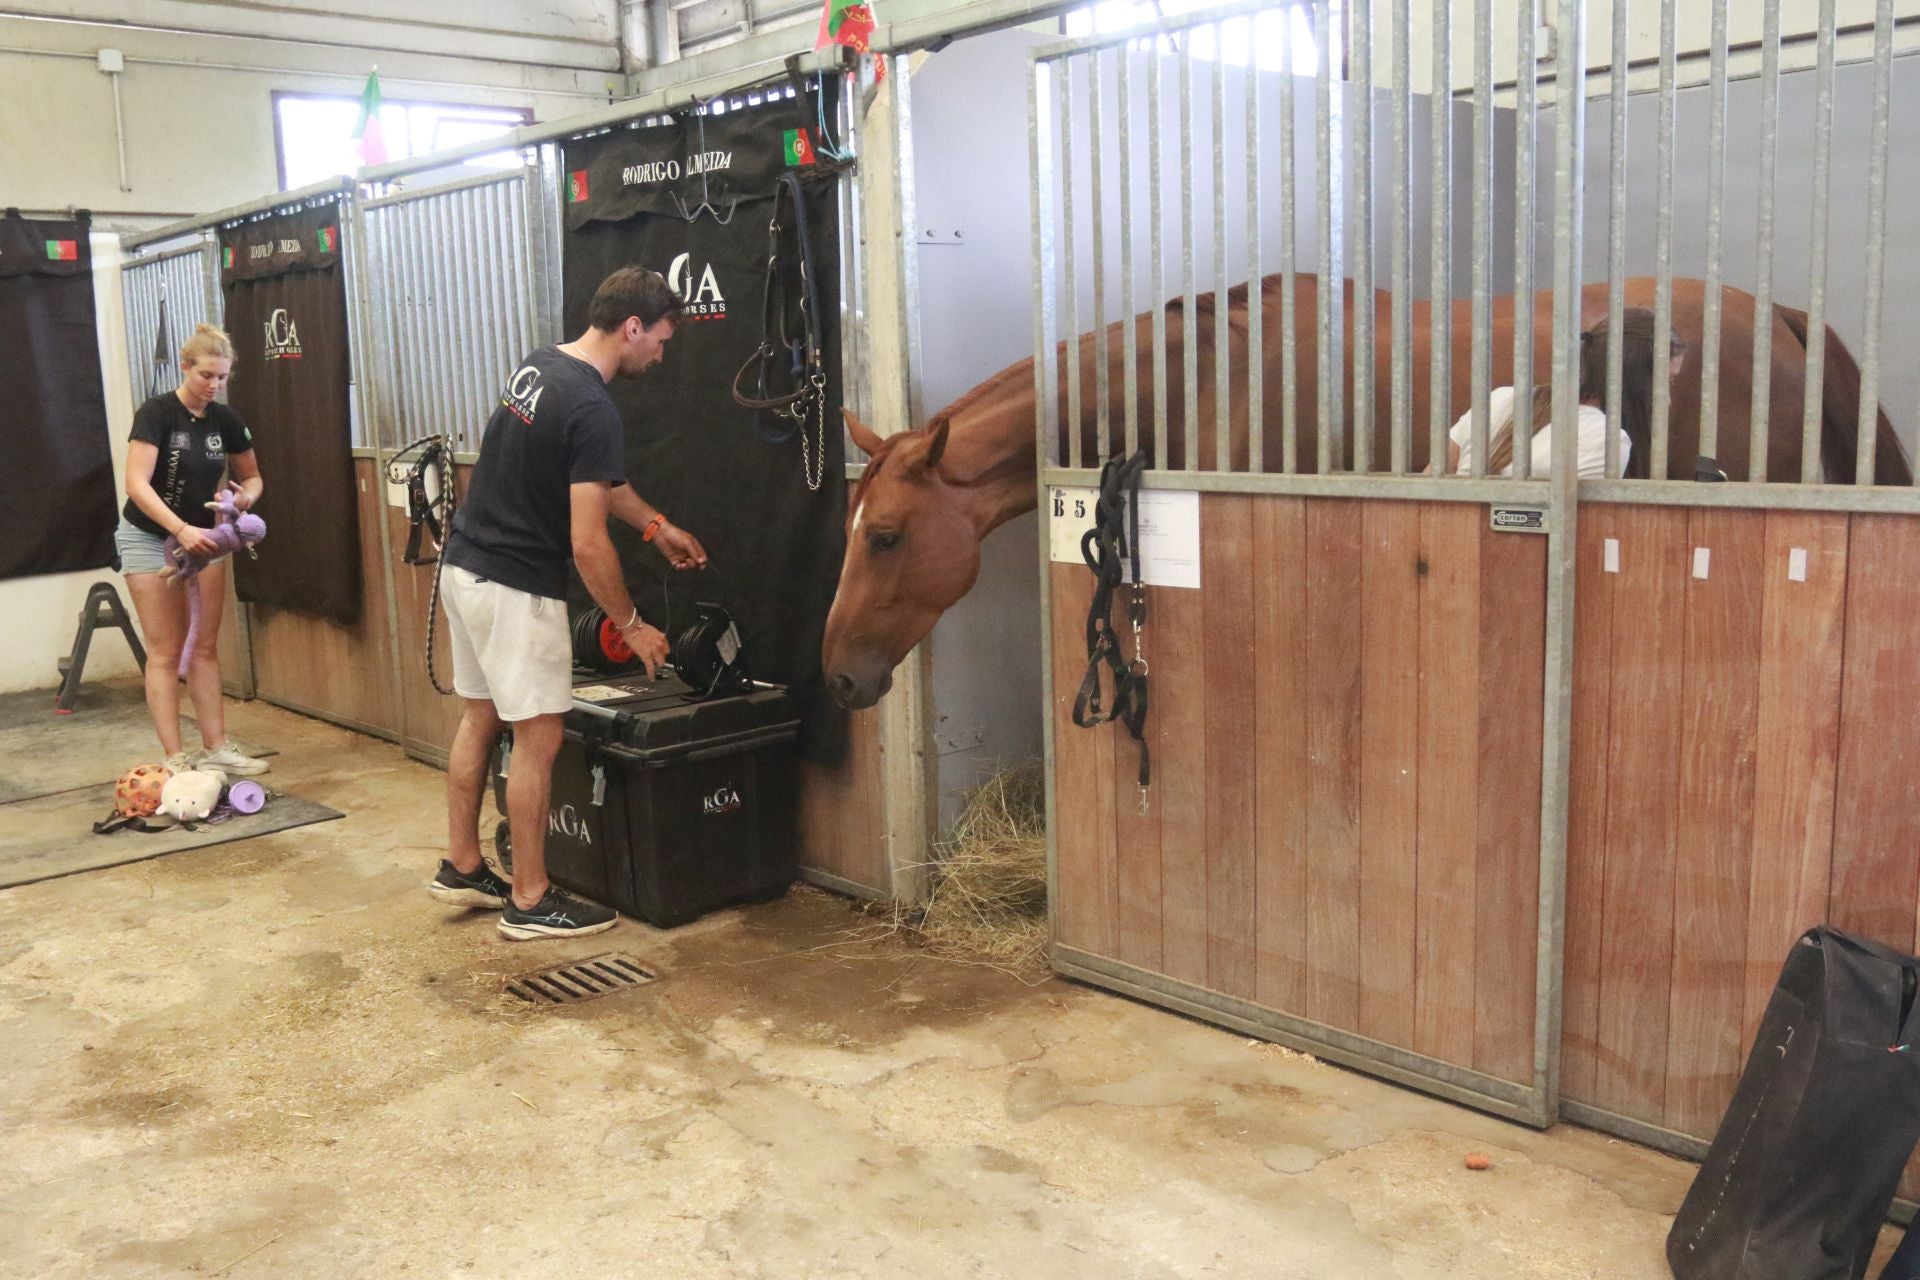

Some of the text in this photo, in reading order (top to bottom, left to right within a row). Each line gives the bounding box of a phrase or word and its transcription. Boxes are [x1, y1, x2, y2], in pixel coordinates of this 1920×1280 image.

[622, 160, 680, 186] RODRIGO
[682, 302, 726, 314] ORSES
[264, 308, 301, 349] RGA
[1053, 498, 1086, 519] B 5
[704, 787, 741, 810] RGA
[549, 804, 592, 845] RGA
